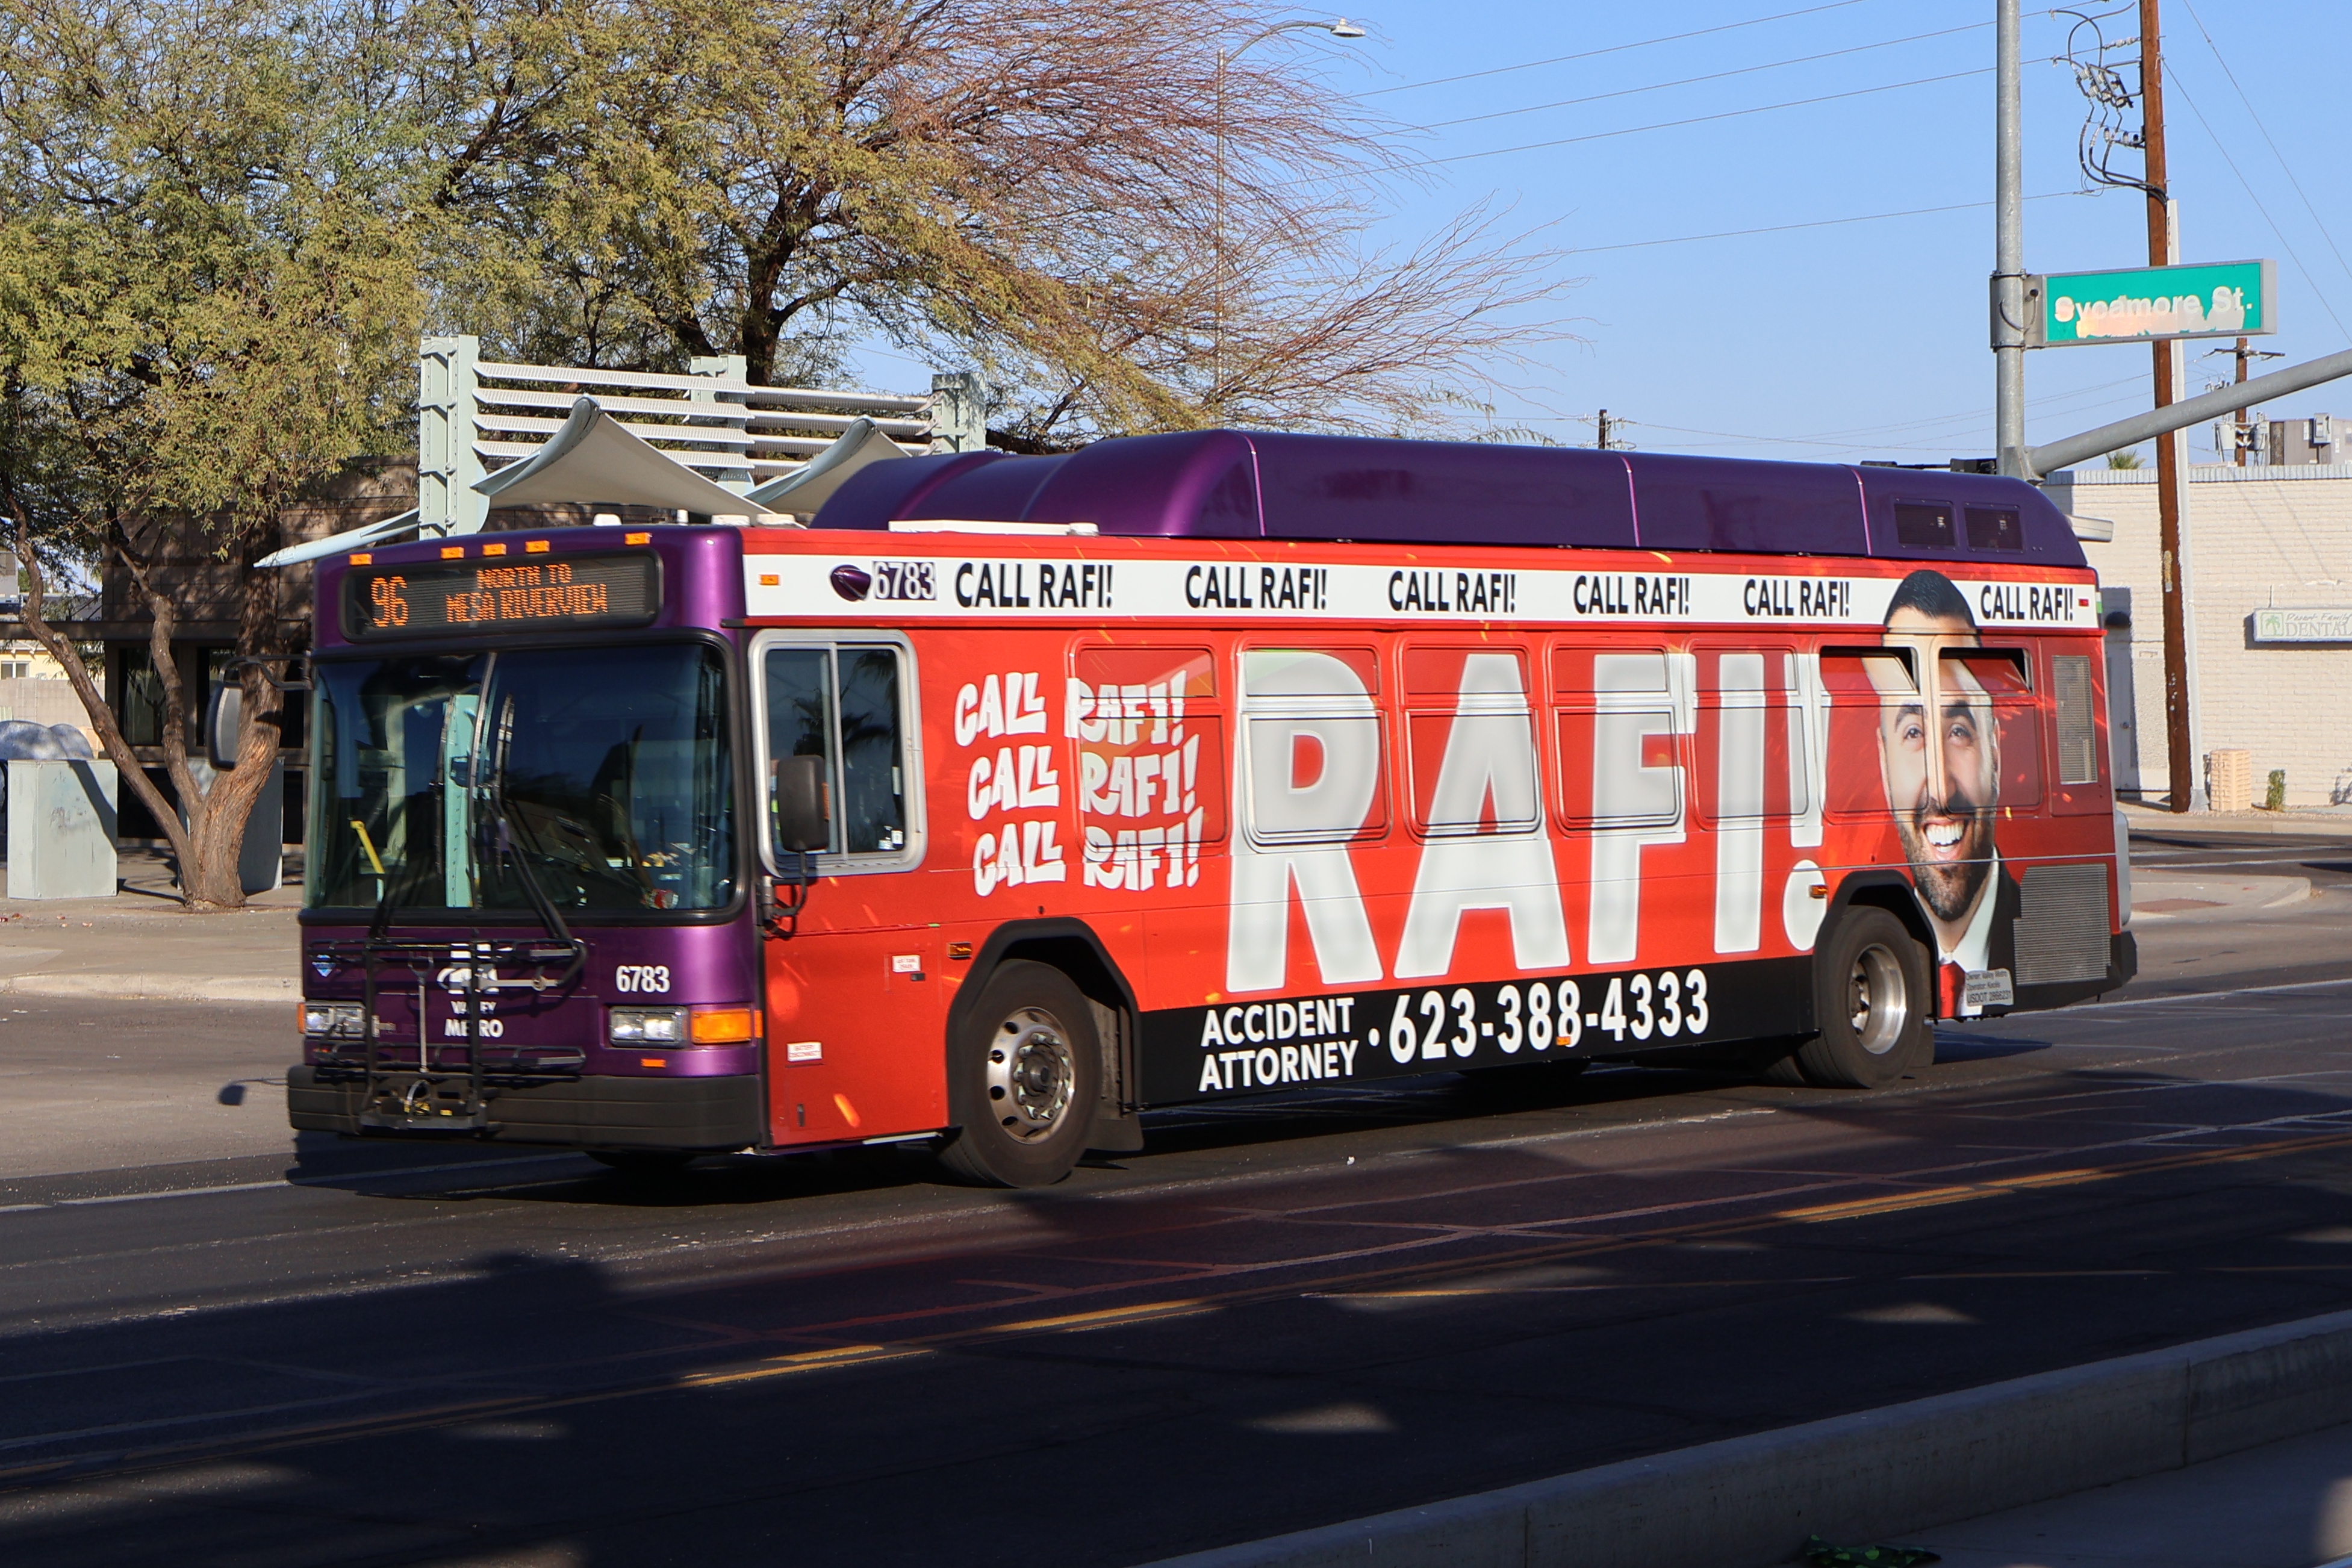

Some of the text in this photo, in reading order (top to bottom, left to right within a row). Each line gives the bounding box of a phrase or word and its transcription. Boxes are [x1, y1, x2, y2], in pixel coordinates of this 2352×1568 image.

[2054, 285, 2254, 326] Sycamore St.
[476, 563, 573, 590] NORTH TO
[875, 561, 936, 600] 6783
[956, 562, 1113, 608] CALL RAFI!
[1186, 565, 1327, 609] CALL RAFI!
[1389, 571, 1516, 612] CALL RAFI!
[1574, 576, 1689, 614] CALL RAFI!
[370, 576, 409, 627] 96
[445, 583, 608, 623] MESA RIVERVIEW
[1744, 579, 1849, 617] CALL RAFI!
[1980, 585, 2073, 621] CALL RAFI!
[2285, 622, 2352, 637] DENTAL
[954, 669, 1187, 747] CALL RAFI!
[967, 733, 1200, 820] CALL RAFI!
[1226, 649, 1827, 994] RAFI!
[972, 805, 1204, 897] CALL RAFI!
[615, 965, 671, 994] 6783
[444, 1018, 505, 1038] MERO
[450, 1000, 497, 1015] VAEY
[1201, 997, 1355, 1047] ACCIDENT
[1389, 968, 1709, 1064] 623-388-4333
[1198, 1039, 1360, 1092] ATTORNEY
